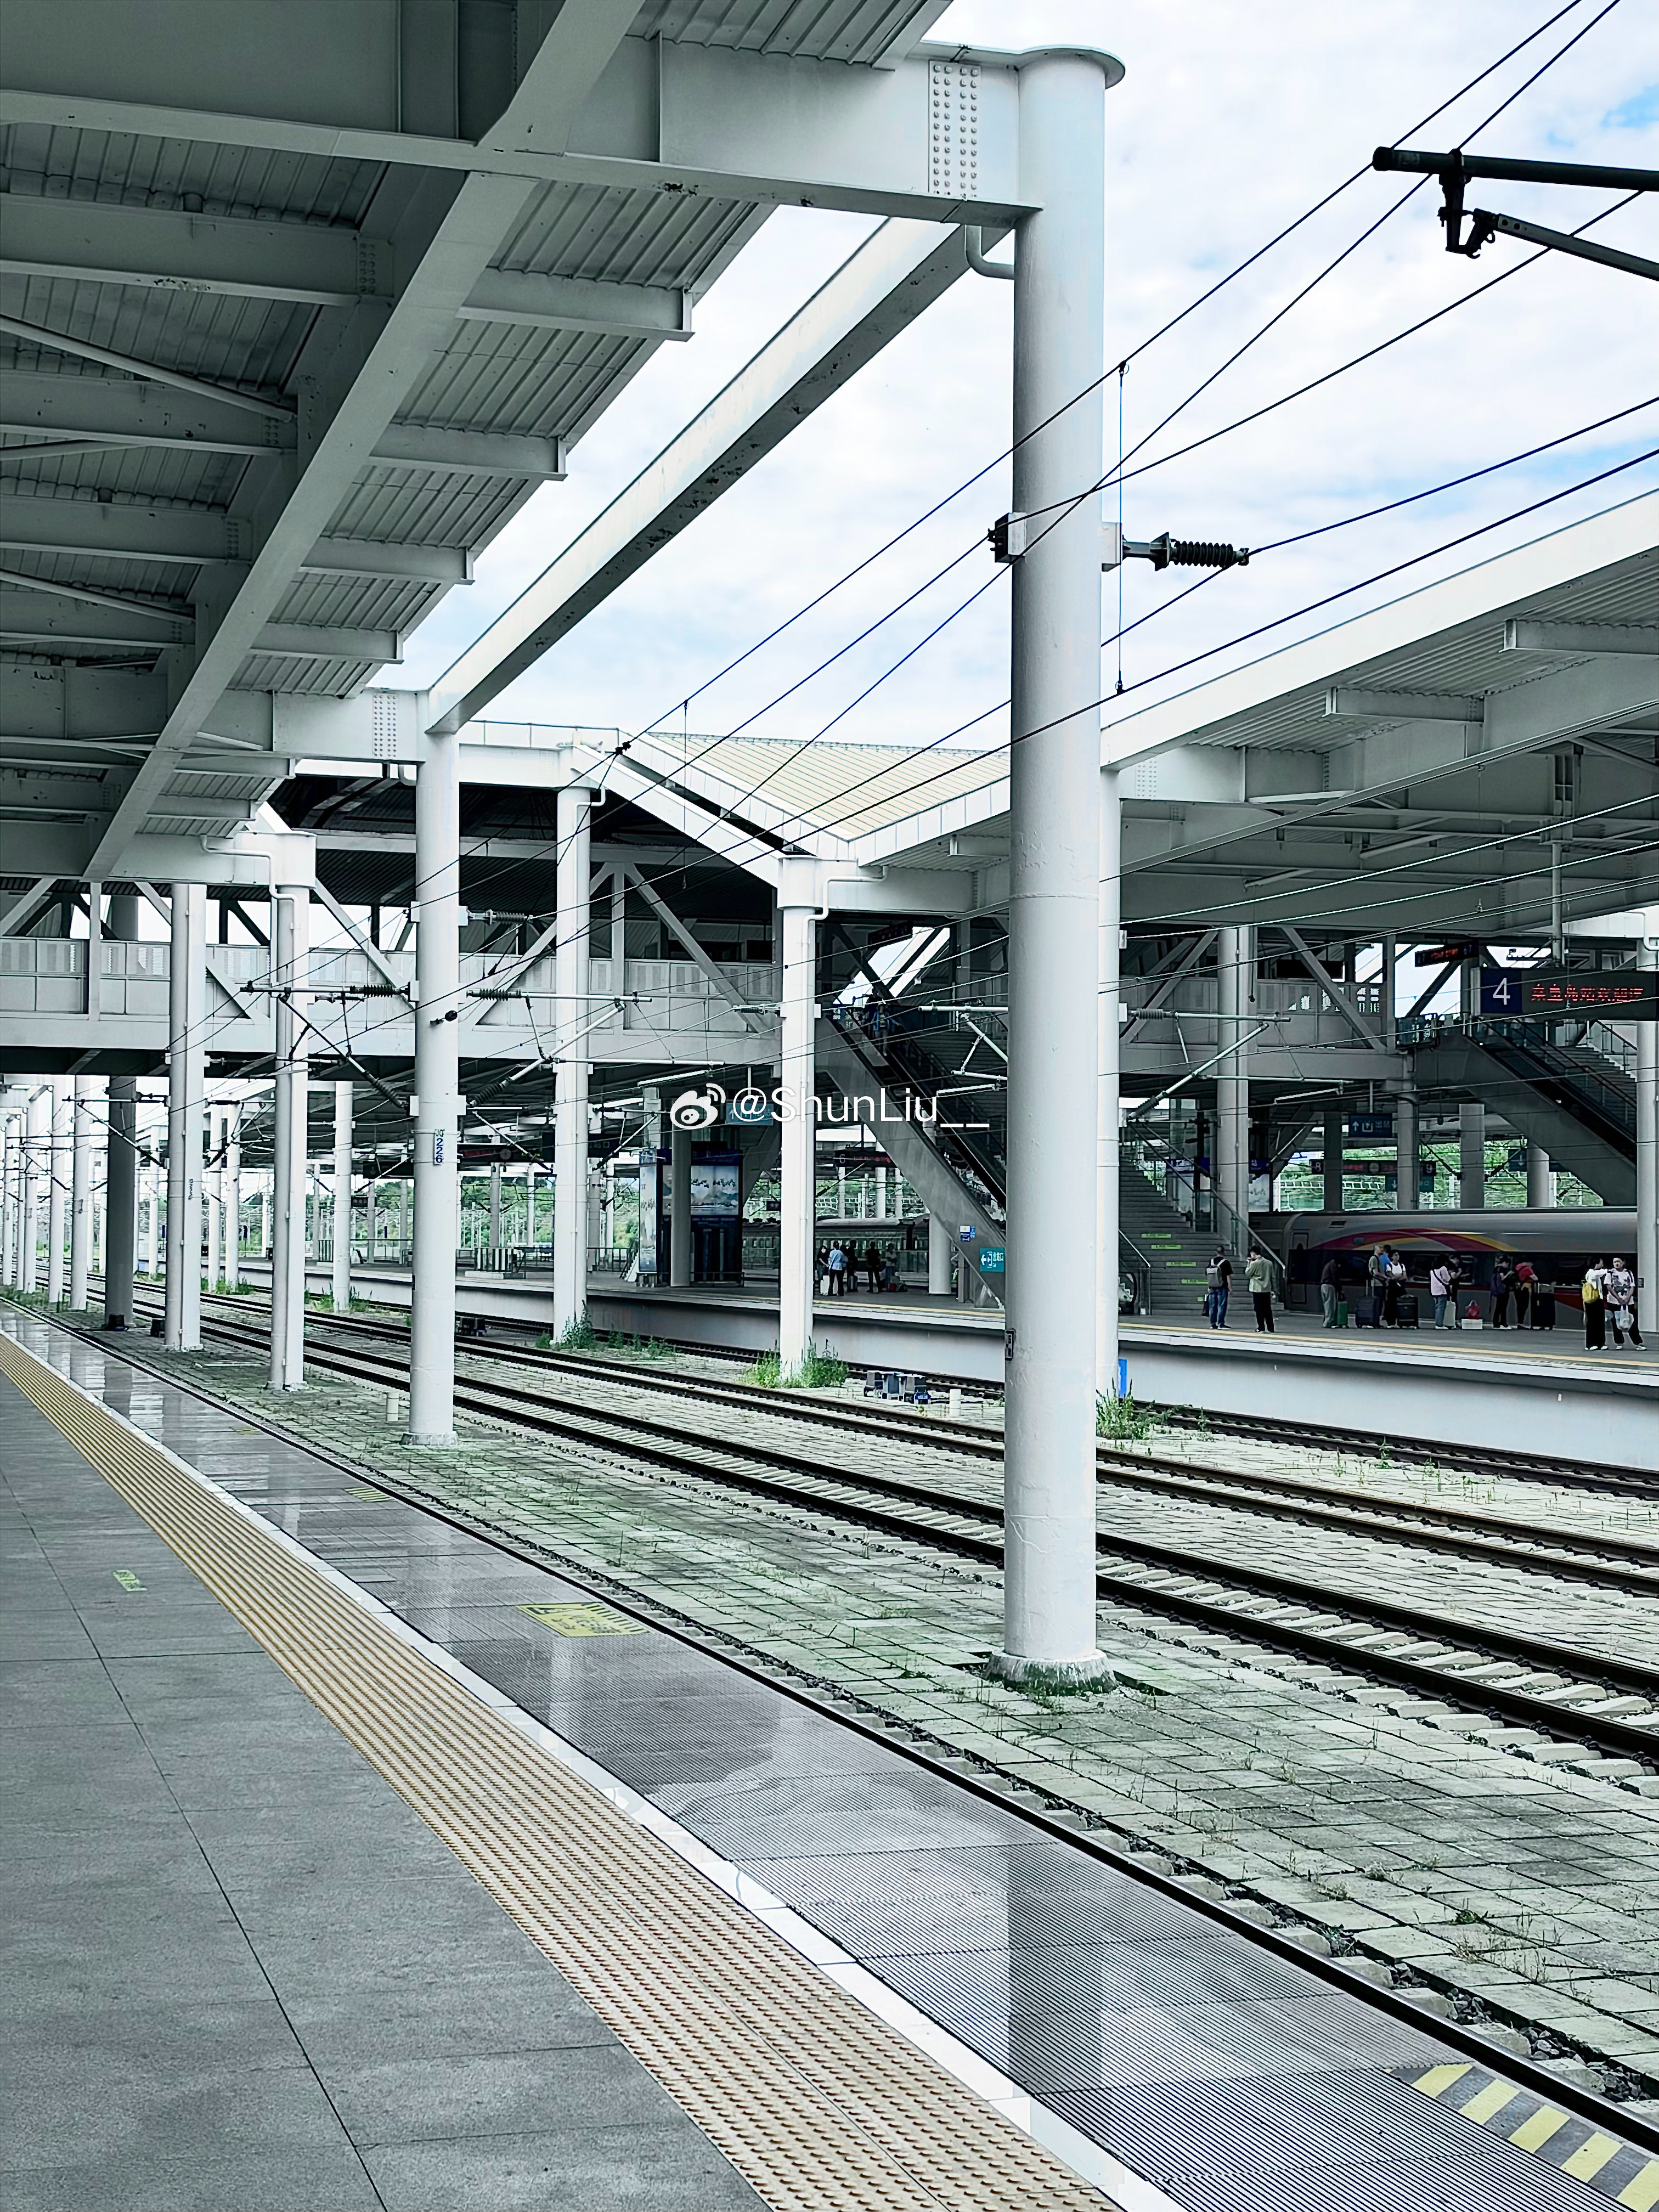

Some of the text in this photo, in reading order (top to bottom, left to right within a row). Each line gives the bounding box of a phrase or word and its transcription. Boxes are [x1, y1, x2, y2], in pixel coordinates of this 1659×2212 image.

[1493, 978, 1511, 1005] 4
[1315, 1162, 1322, 1172] 8
[1426, 1164, 1433, 1173] 9
